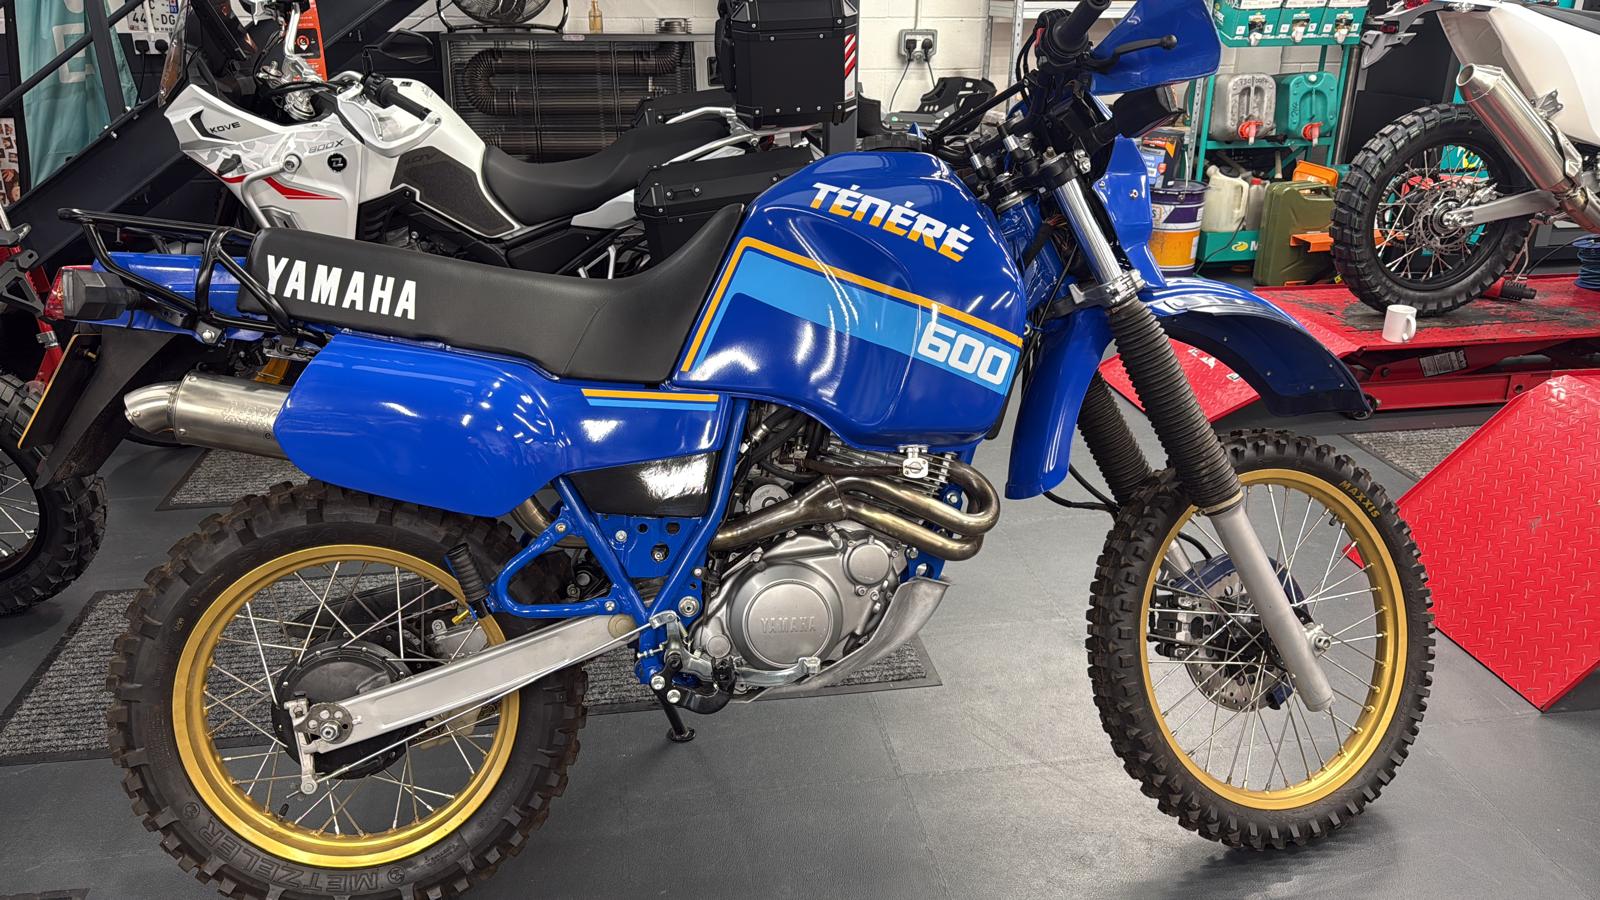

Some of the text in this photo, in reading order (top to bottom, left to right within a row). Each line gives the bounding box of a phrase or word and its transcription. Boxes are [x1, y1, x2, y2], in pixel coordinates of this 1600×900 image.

[210, 121, 241, 133] KOVE
[308, 139, 344, 153] 800X
[267, 255, 416, 320] YAMAHA
[918, 322, 1011, 385] 600
[1340, 481, 1381, 518] MAXXIS
[761, 616, 816, 633] YAMAHA
[200, 818, 378, 893] METZELER
